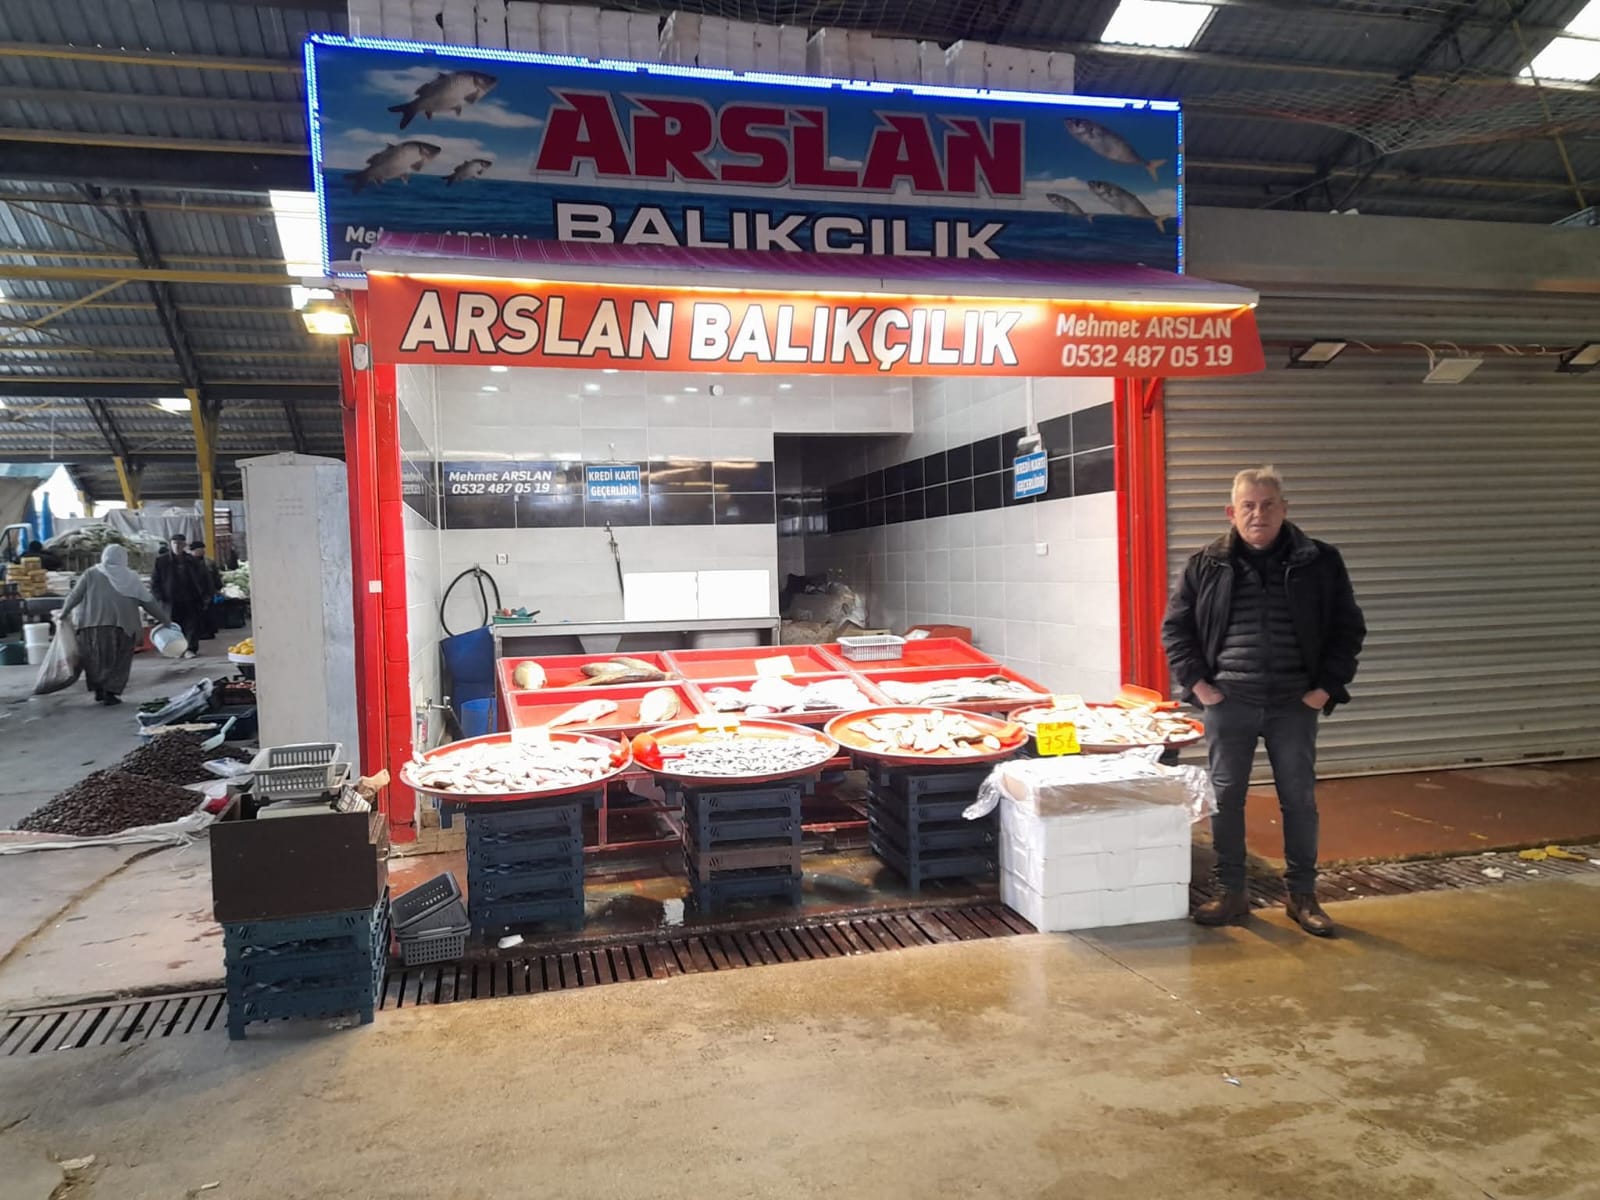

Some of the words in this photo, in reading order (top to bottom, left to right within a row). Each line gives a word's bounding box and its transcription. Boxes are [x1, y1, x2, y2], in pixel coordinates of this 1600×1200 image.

[534, 86, 1026, 199] ARSLAN
[400, 290, 675, 359] ARSLAN
[689, 301, 1022, 371] BALIKÇILIK
[1056, 313, 1141, 338] Mehmet
[1145, 316, 1232, 339] ARSLAN
[1061, 344, 1118, 368] 0532
[1123, 345, 1166, 368] 487
[1170, 346, 1199, 368] 05
[1205, 344, 1233, 367] 19
[449, 471, 498, 482] Mehmet
[502, 470, 552, 482] ARSLAN
[588, 469, 613, 481] KREDİ
[615, 470, 638, 481] KARTI
[452, 483, 484, 495] 0532
[487, 483, 512, 495] 487
[514, 483, 532, 494] 05
[534, 483, 550, 494] 19
